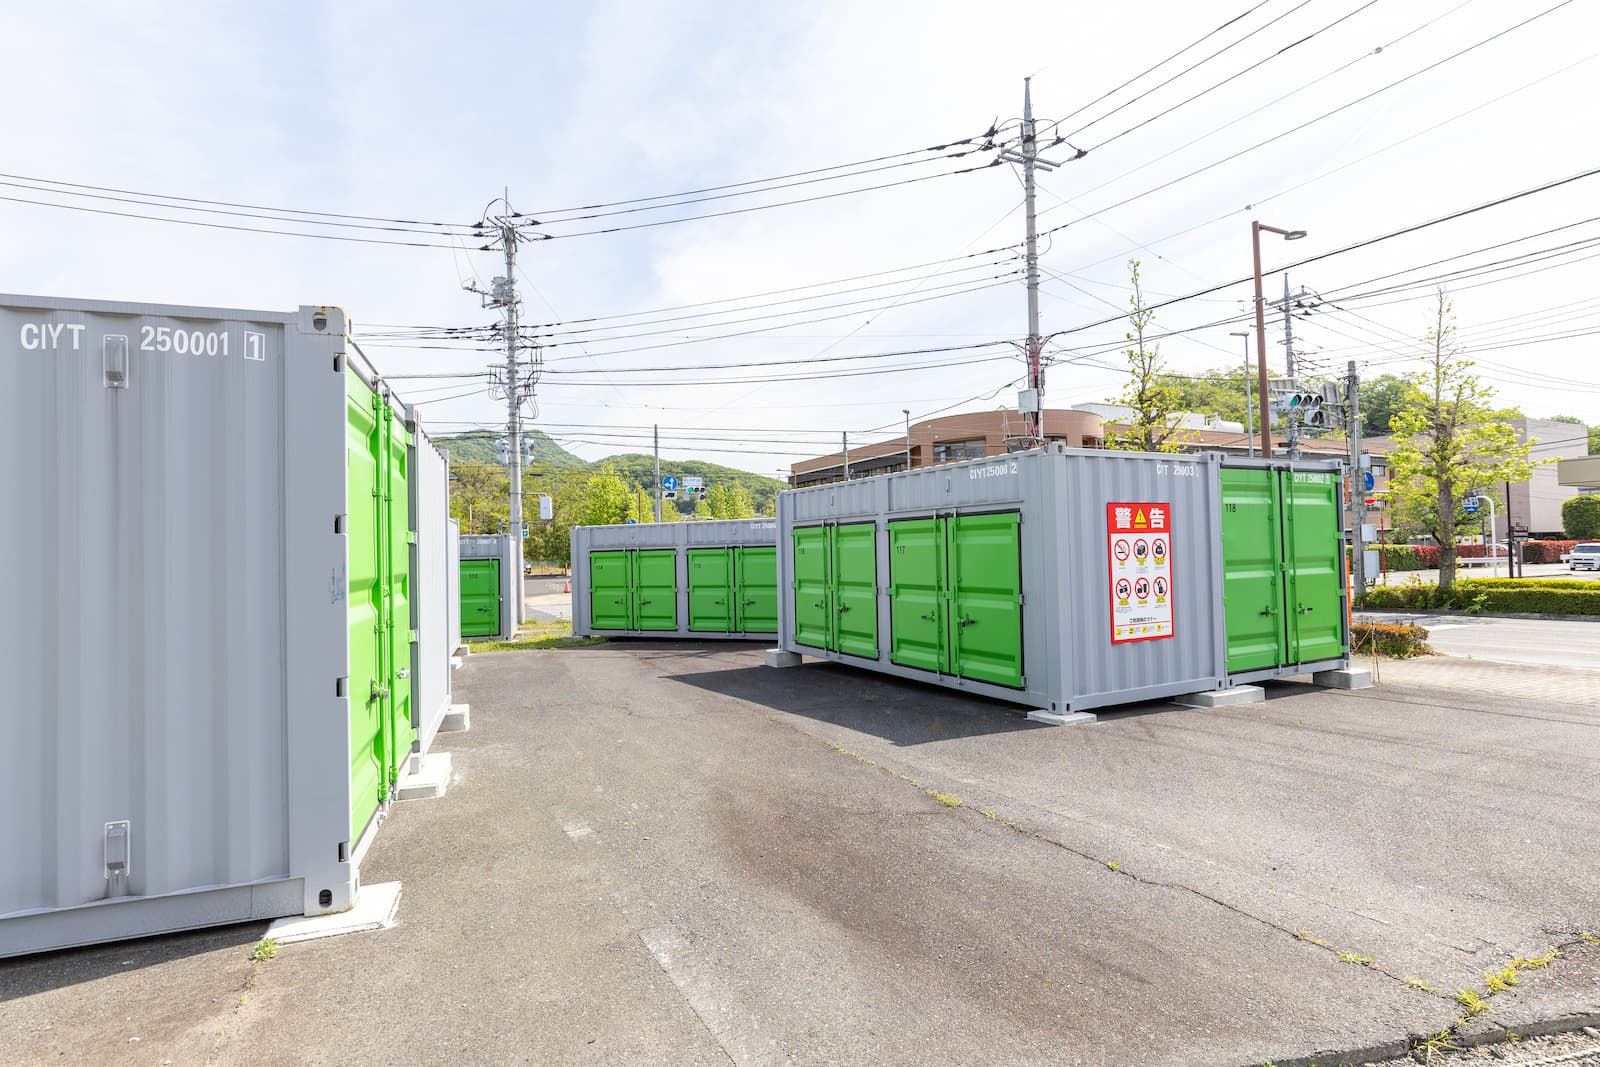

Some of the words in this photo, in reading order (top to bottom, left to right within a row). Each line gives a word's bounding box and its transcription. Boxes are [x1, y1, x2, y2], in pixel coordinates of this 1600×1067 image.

[20, 323, 85, 351] CIYT
[140, 326, 228, 356] 250001
[246, 332, 263, 360] 1
[1225, 504, 1236, 513] 118
